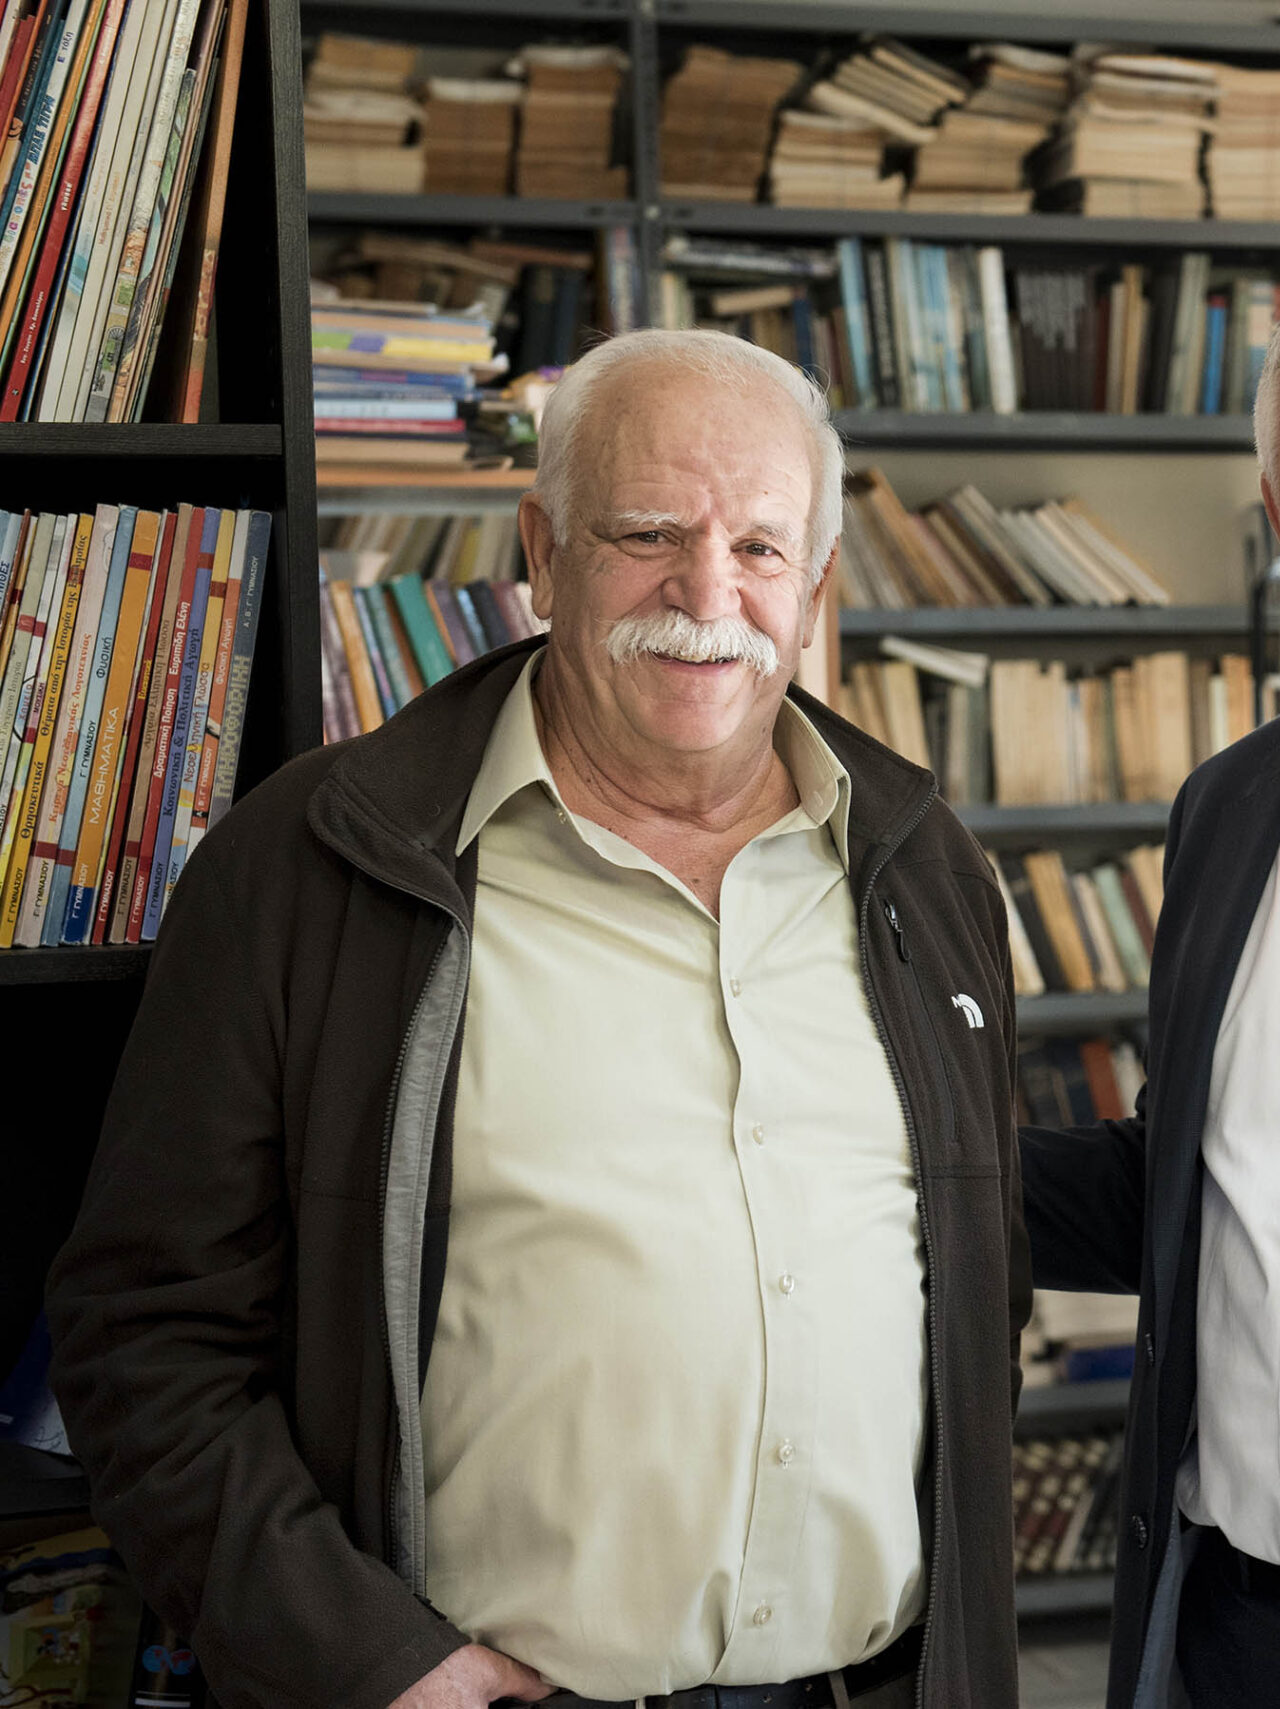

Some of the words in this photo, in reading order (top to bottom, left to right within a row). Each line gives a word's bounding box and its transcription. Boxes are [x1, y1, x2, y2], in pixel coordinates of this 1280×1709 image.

[245, 555, 260, 596] ΓΥΜΝΑΣΙΟΥ
[65, 590, 77, 609] της
[175, 600, 189, 629] Ελένη
[56, 610, 74, 650] Ιστορία
[168, 630, 186, 675] Ευριπίδη
[220, 617, 234, 649] Αγωγή
[53, 652, 65, 671] την
[71, 632, 91, 698] Λογοτεχνίας
[95, 635, 112, 679] Φυσική
[214, 650, 229, 684] Φυσική
[33, 681, 44, 713] ΜΟΥΣΙΚΗ
[48, 672, 61, 694] από
[146, 660, 164, 708] Ελληνική
[161, 687, 176, 723] Ποίηση
[41, 695, 57, 737] Θέματα
[162, 751, 183, 816] Κοινωνική
[173, 734, 183, 747] &
[183, 627, 201, 670] Αγωγή
[183, 709, 203, 783] Νεοελληνική
[193, 661, 211, 708] Γλώσσα
[216, 654, 248, 798] ΠΛΗΡΟΦΟΡΙΚΗ
[81, 719, 96, 768] ΓΥΜΝΑΣΙΟΥ
[89, 705, 118, 824] ΜΑΘΗΜΑΤΙΚΑ
[152, 724, 171, 778] Δραματική
[20, 759, 46, 840] Θρησκευτικά
[9, 867, 23, 913] ΓΥΜΝΑΣΙΟΥ
[34, 859, 49, 907] ΓΥΜΝΑΣΙΟΥ
[73, 862, 88, 909] ΓΥΜΝΑΣΙΟΥ
[100, 869, 114, 912] ΓΥΜΝΑΣΙΟΥ
[117, 858, 133, 905] ΓΥΜΝΑΣΙΟΥ
[132, 874, 146, 915] ΓΥΜΝΑΣΙΟΥ
[149, 861, 164, 908] ΓΥΜΝΑΣΙΟΥ
